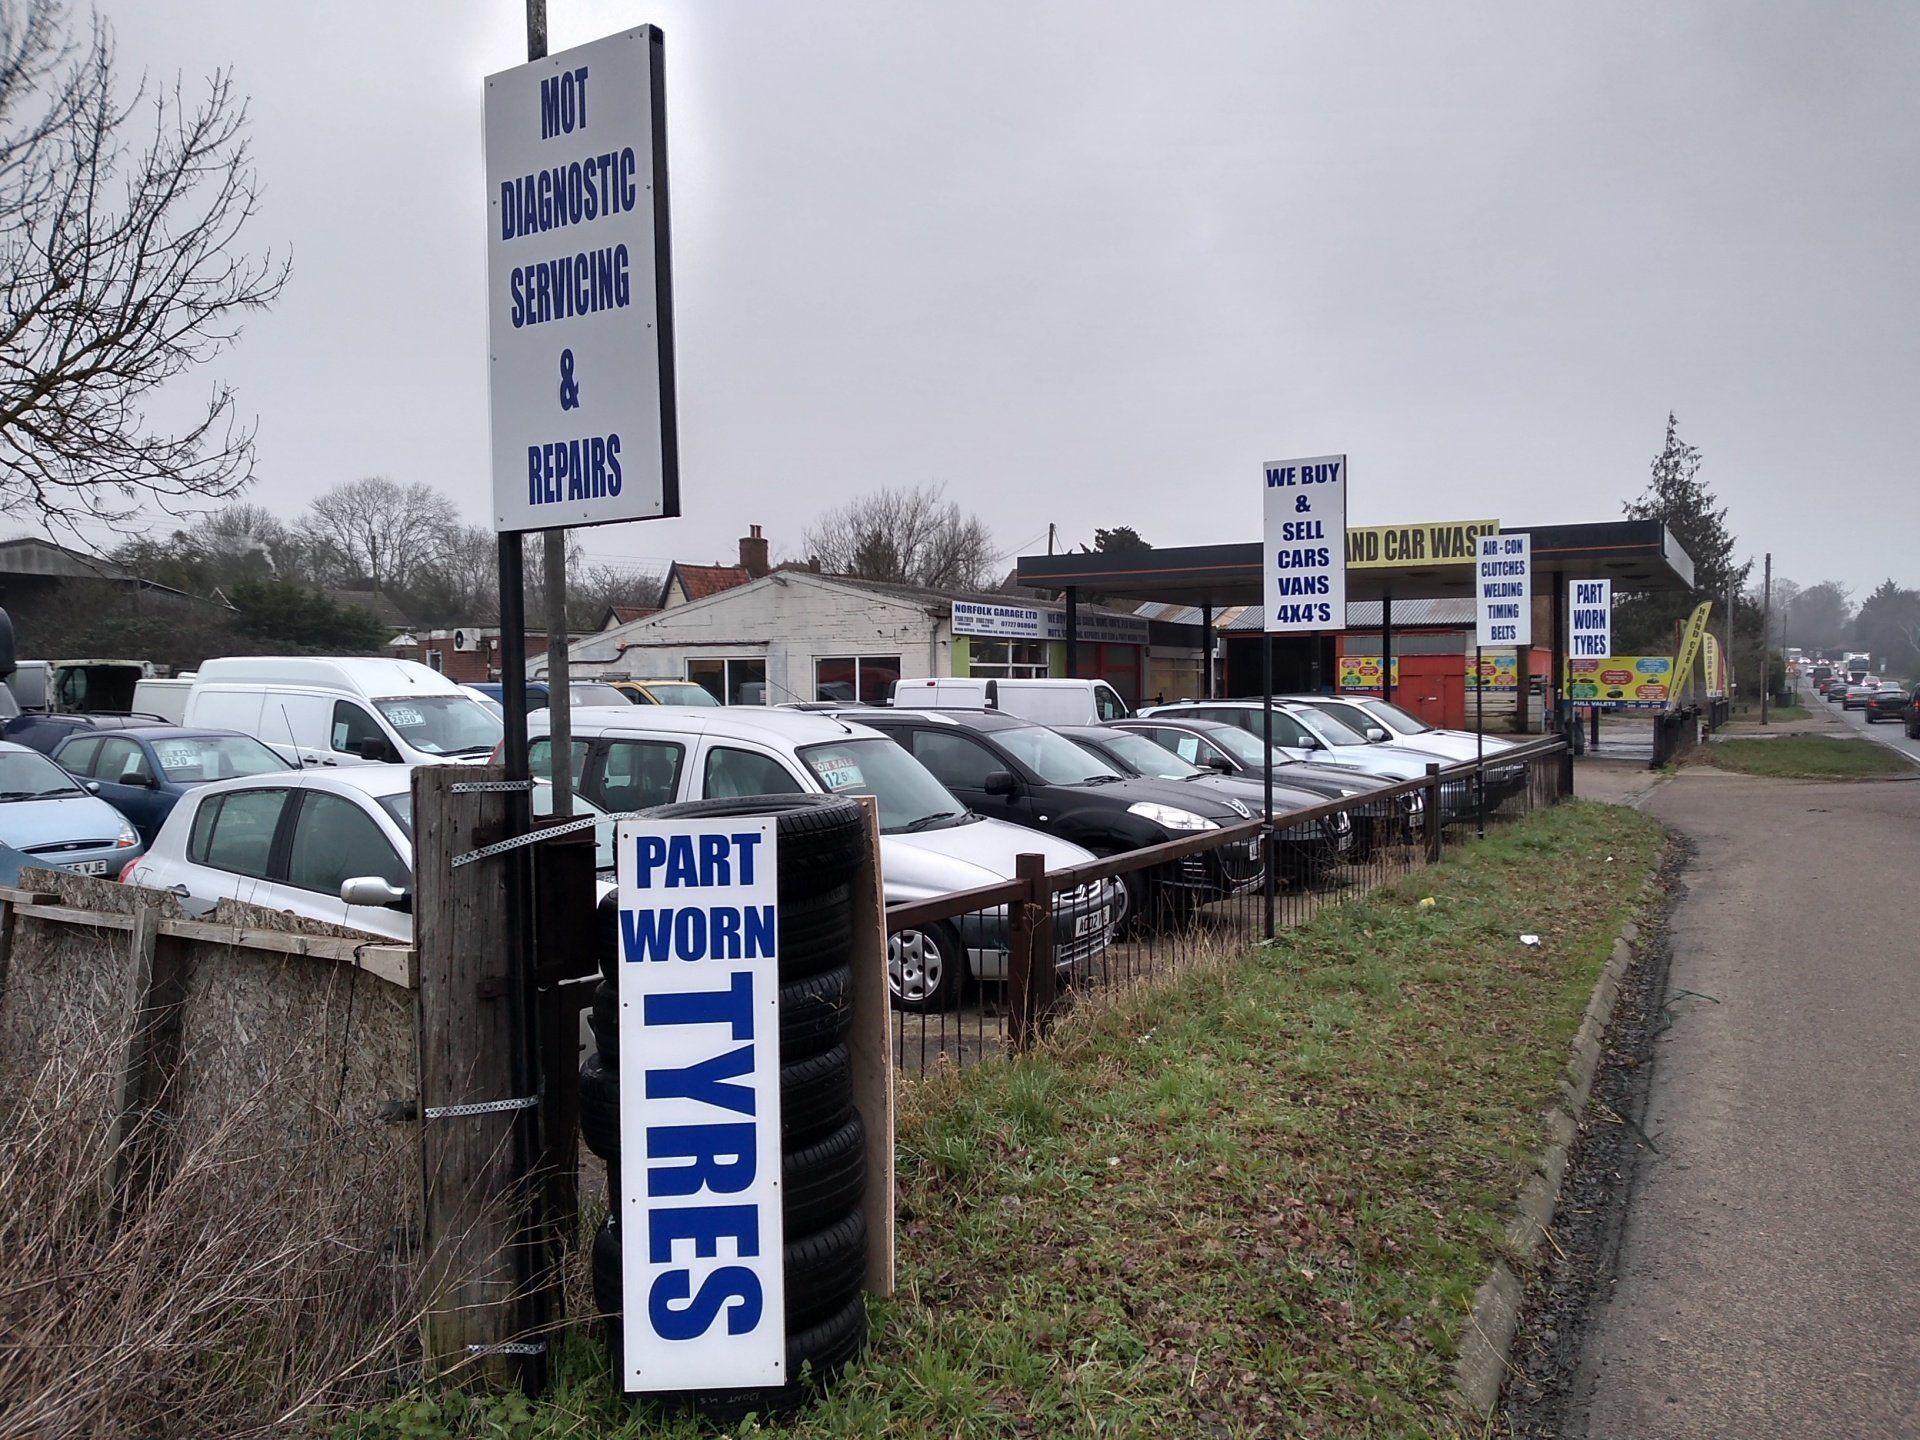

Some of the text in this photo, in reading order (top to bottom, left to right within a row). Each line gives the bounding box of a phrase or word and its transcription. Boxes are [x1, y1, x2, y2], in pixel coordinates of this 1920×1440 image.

[540, 66, 588, 140] MOT
[501, 146, 636, 240] DIAGNOSTIC
[511, 243, 630, 329] SERVICING
[559, 348, 579, 411] &
[528, 433, 622, 505] REPAIRS
[1266, 463, 1340, 488] WE BUY
[1295, 495, 1311, 513] &
[1282, 520, 1324, 541] SELL
[1346, 531, 1378, 563] ND
[1384, 528, 1425, 561] CAR
[1483, 541, 1498, 556] AIR
[1505, 538, 1523, 554] CON
[1277, 547, 1330, 569] CARS
[1481, 560, 1525, 577] CLUTCHES
[1277, 575, 1330, 596] VANS
[1484, 582, 1523, 598] WELDING
[1577, 583, 1604, 604] PART
[954, 604, 1038, 620] NORFOLK GARAGE LTD
[1277, 602, 1331, 623] 4X4'S
[1488, 604, 1519, 619] TIMING
[1574, 608, 1606, 630] WORN
[1491, 625, 1516, 640] BELTS
[1691, 607, 1706, 638] HAND
[1574, 634, 1606, 655] TYRES
[83, 861, 105, 874] VJE
[636, 833, 762, 889] PART
[619, 905, 775, 962] WORN
[643, 971, 763, 1341] TYRES
